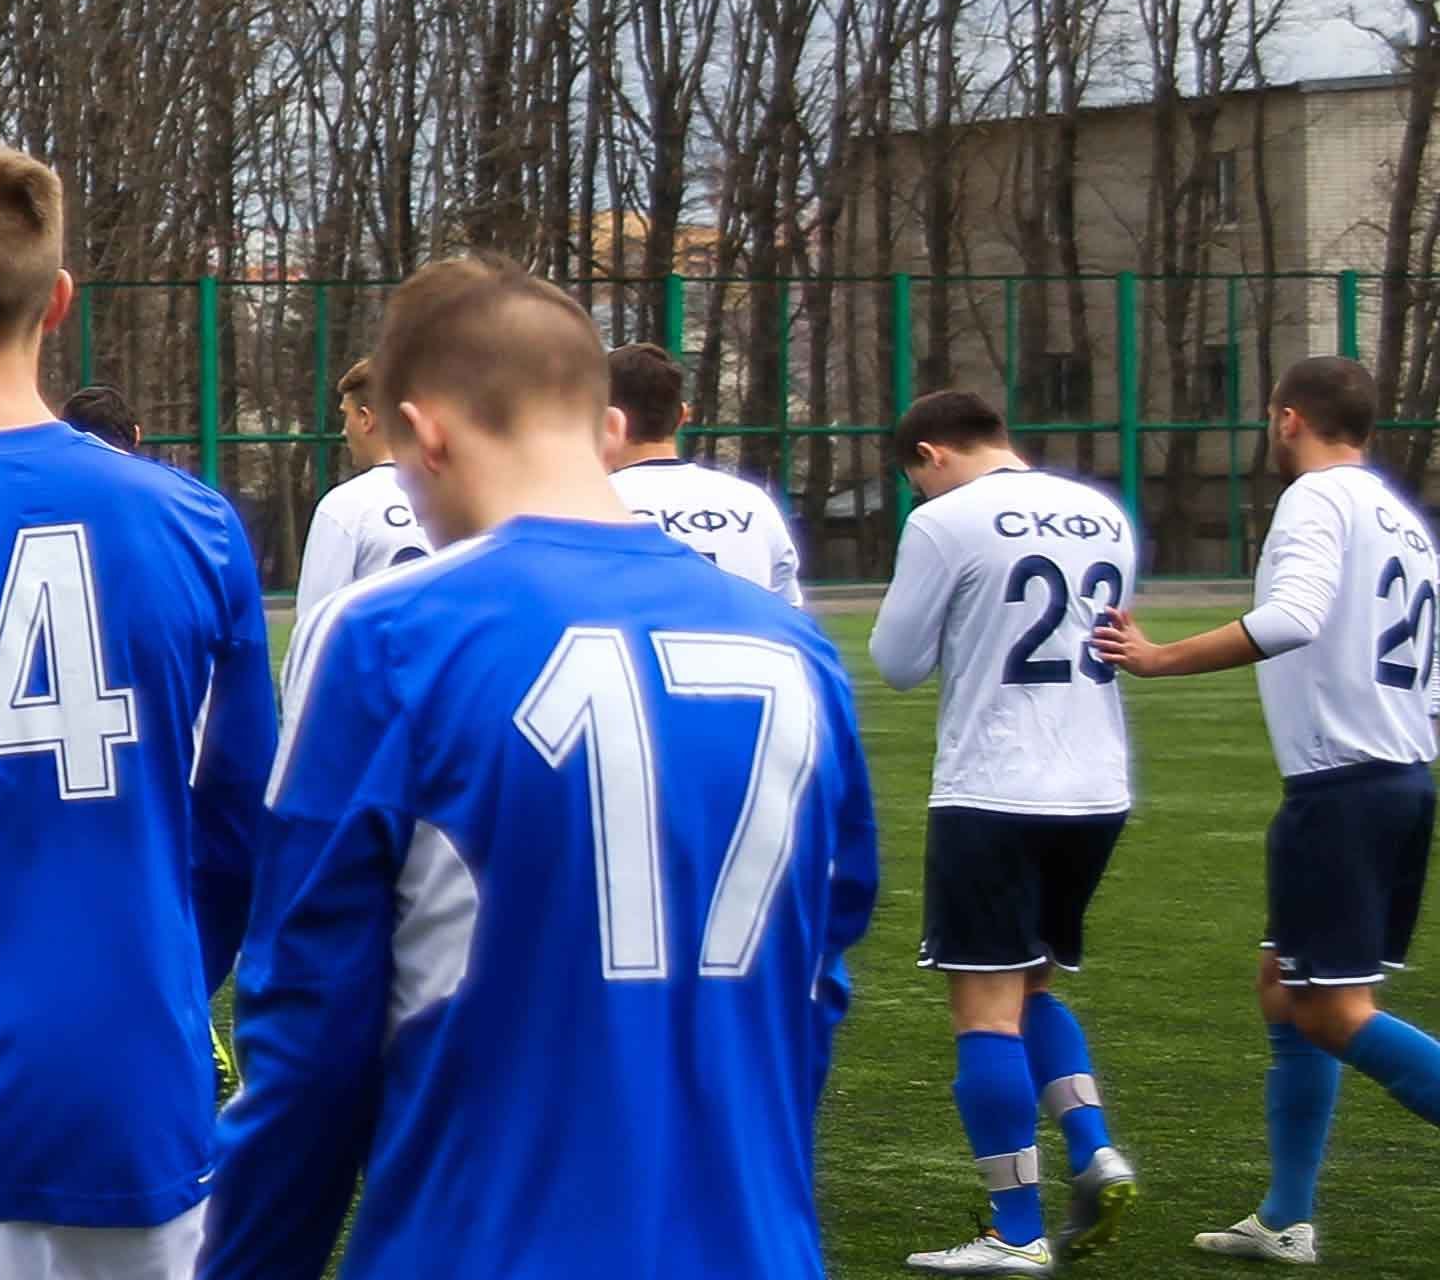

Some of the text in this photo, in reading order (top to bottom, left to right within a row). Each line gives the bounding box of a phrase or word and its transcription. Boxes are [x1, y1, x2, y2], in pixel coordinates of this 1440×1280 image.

[993, 511, 1122, 542] СКФУ
[1374, 555, 1436, 690] 20
[512, 626, 818, 981] 17
